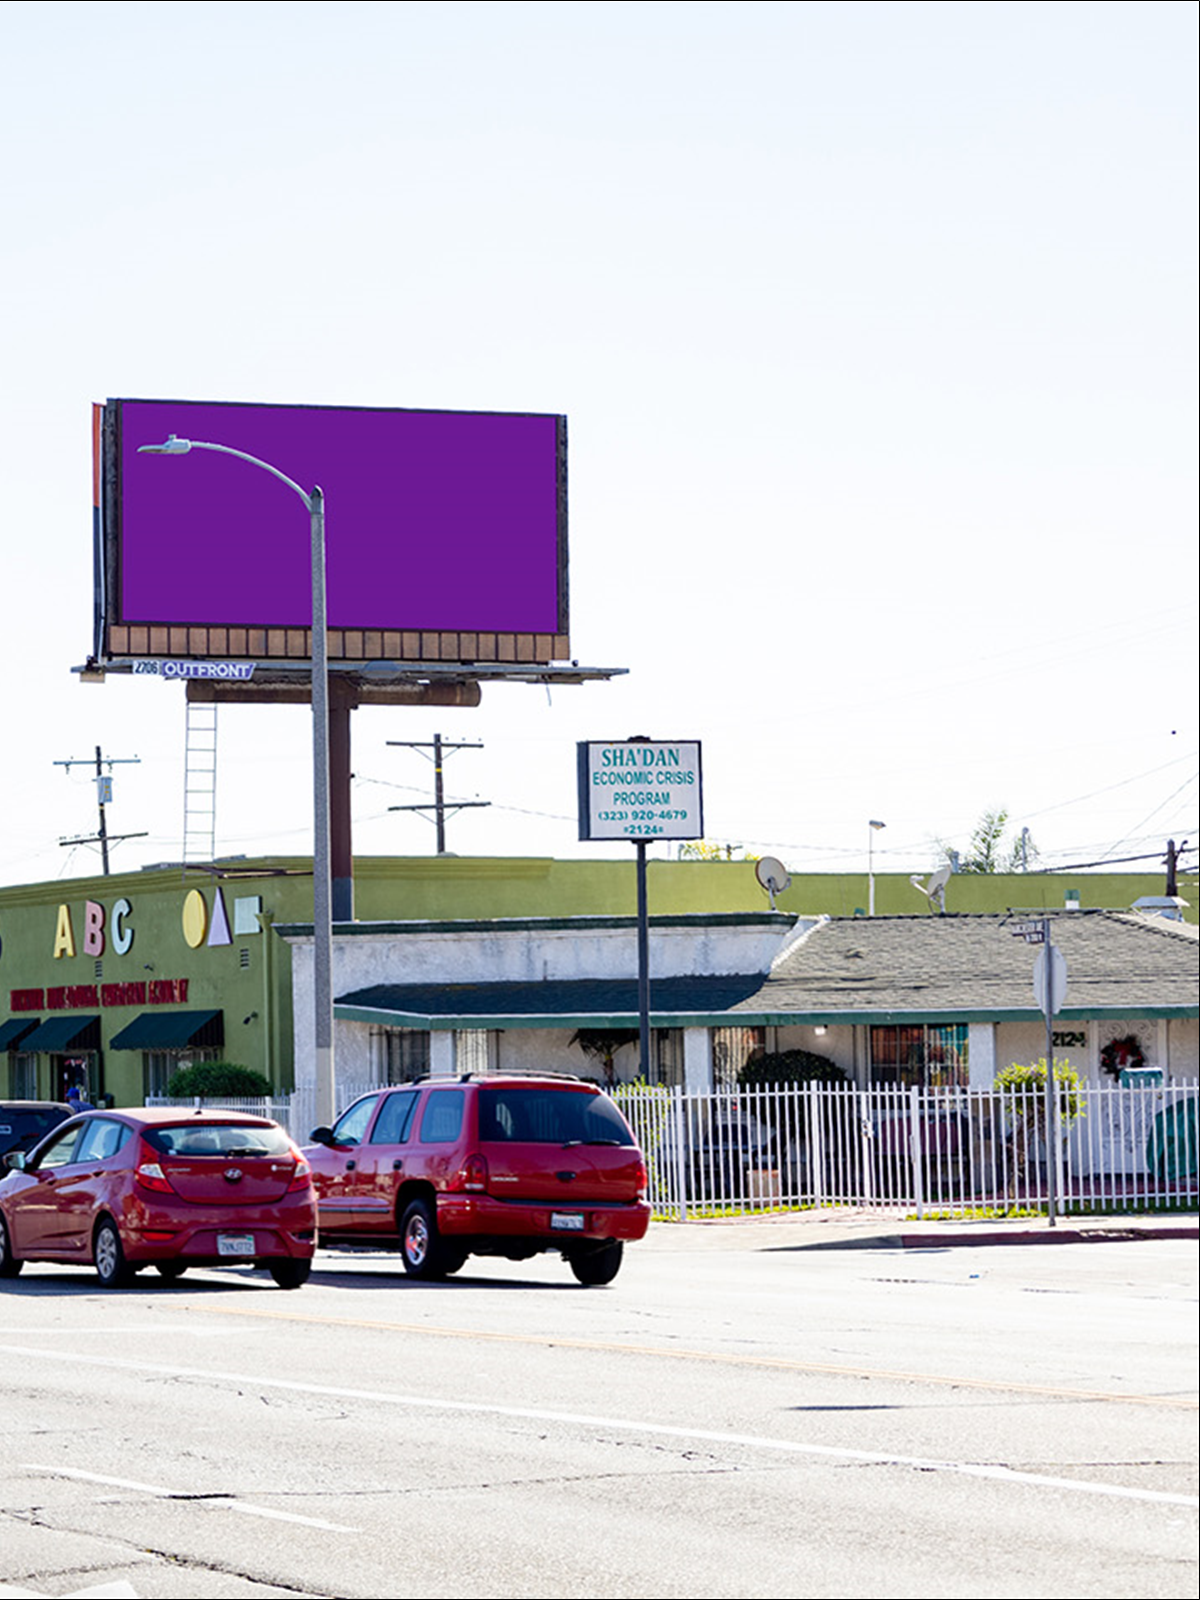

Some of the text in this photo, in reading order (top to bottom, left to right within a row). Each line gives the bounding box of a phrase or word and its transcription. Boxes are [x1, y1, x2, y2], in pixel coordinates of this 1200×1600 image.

[164, 662, 250, 677] OUTFRONT
[601, 748, 680, 767] SHA'DAN
[592, 770, 695, 786] ECONOMIC CRISIS
[613, 791, 671, 806] PROGRAM
[598, 809, 688, 821] (323) 920-4679
[53, 898, 135, 959] ABC
